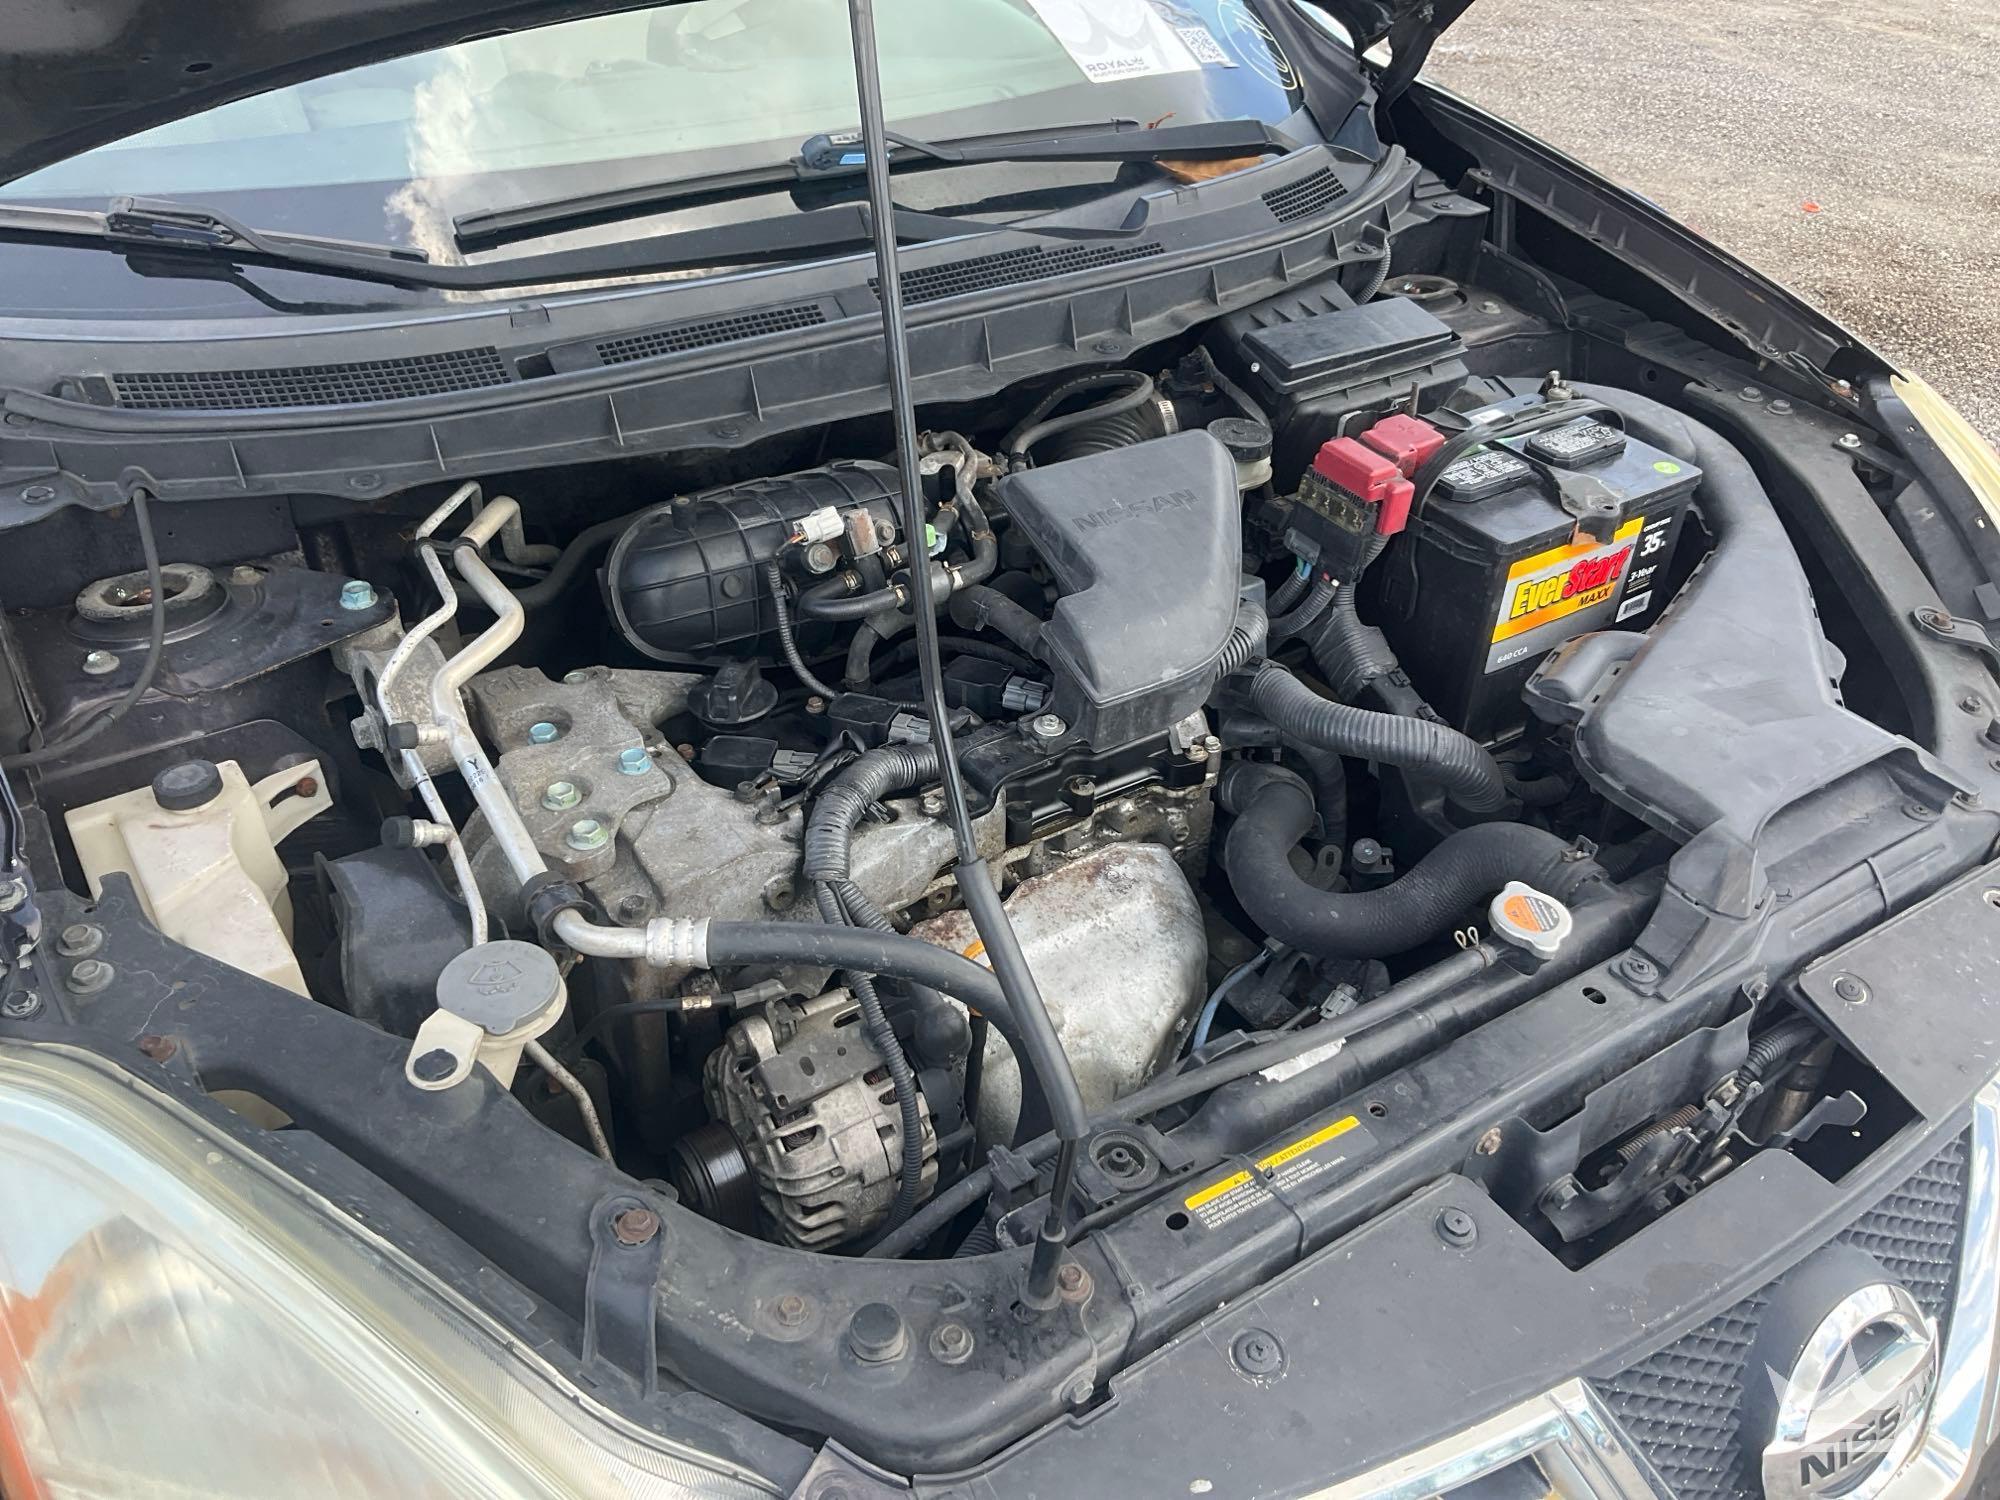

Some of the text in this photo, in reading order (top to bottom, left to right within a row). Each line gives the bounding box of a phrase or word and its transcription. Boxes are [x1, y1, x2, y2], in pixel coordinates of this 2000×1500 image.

[1086, 59, 1134, 72] ROYAL
[1072, 488, 1200, 533] NISSAN
[1627, 564, 1658, 583] 3-Year
[1577, 586, 1611, 608] MAXX
[1497, 646, 1528, 664] 640 CCA
[1279, 1140, 1316, 1161] ATTENTION
[1800, 1360, 1937, 1488] NISSAN
